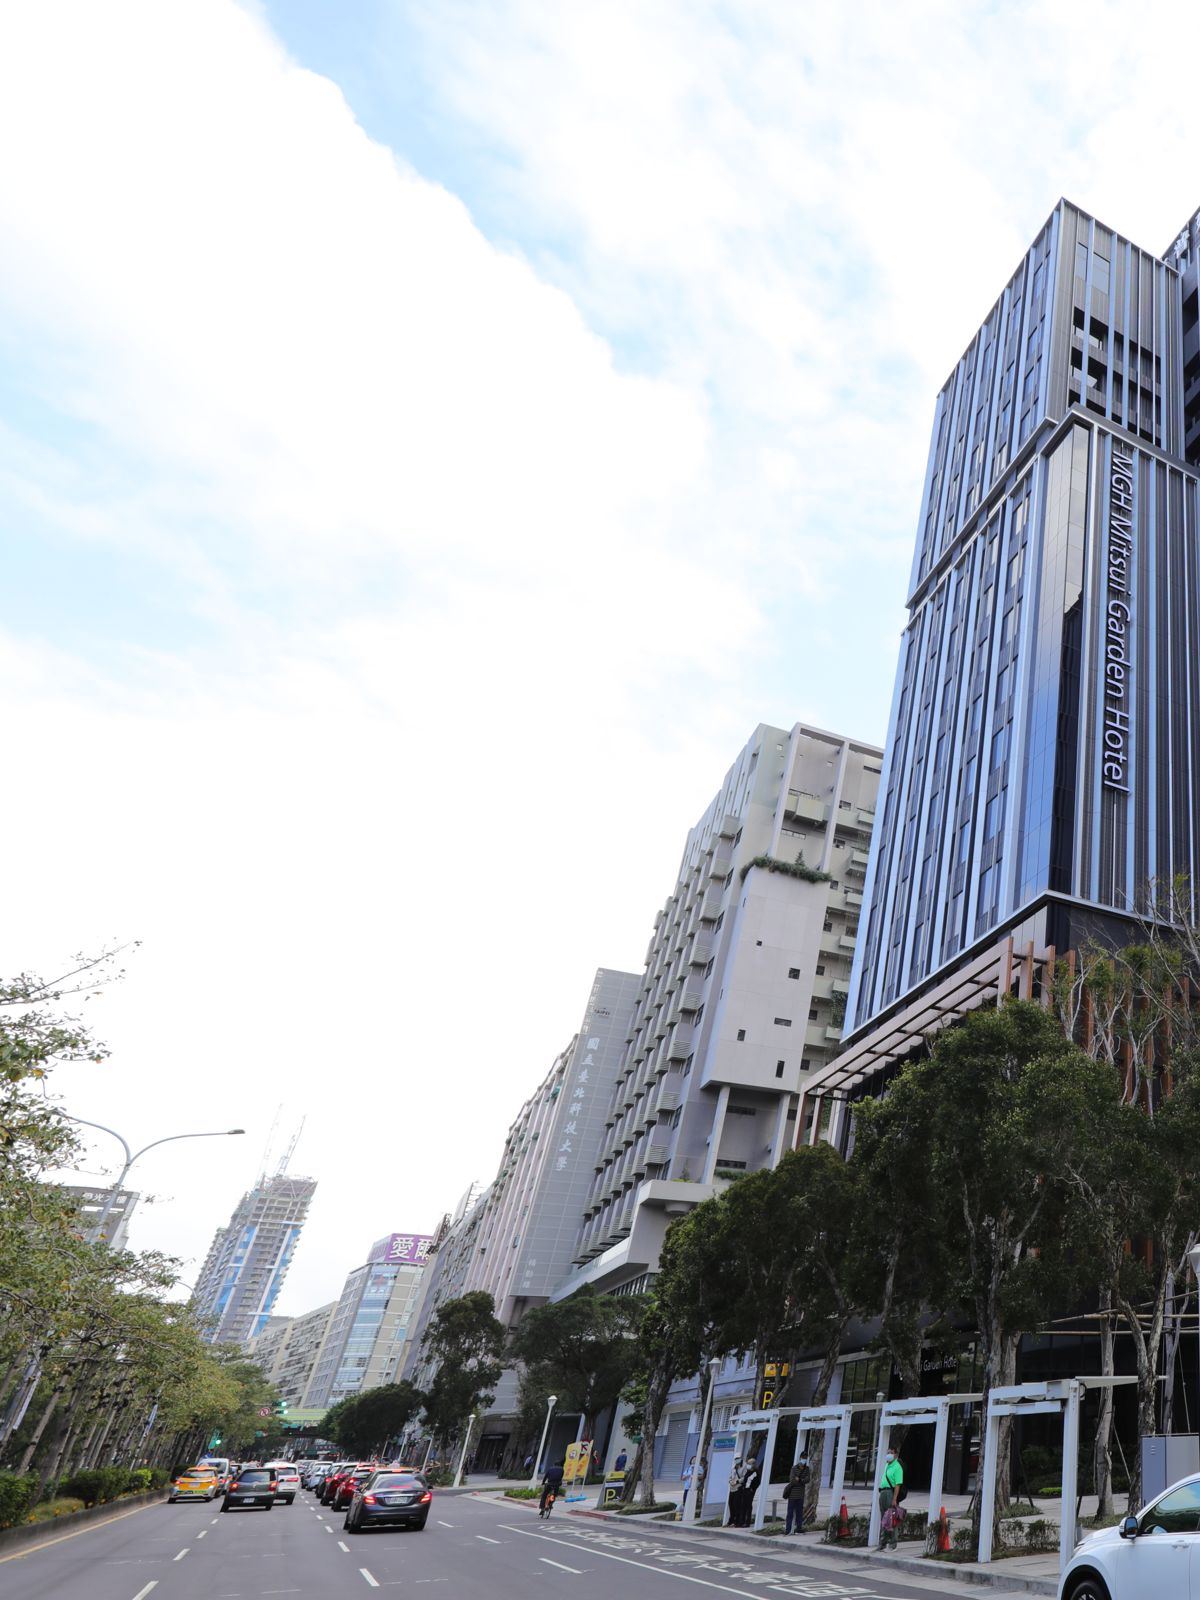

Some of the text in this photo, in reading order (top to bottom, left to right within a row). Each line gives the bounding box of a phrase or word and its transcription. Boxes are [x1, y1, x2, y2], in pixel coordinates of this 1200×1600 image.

[1104, 450, 1133, 792] MGH Mitsui Garden Hotel
[605, 1488, 617, 1505] P
